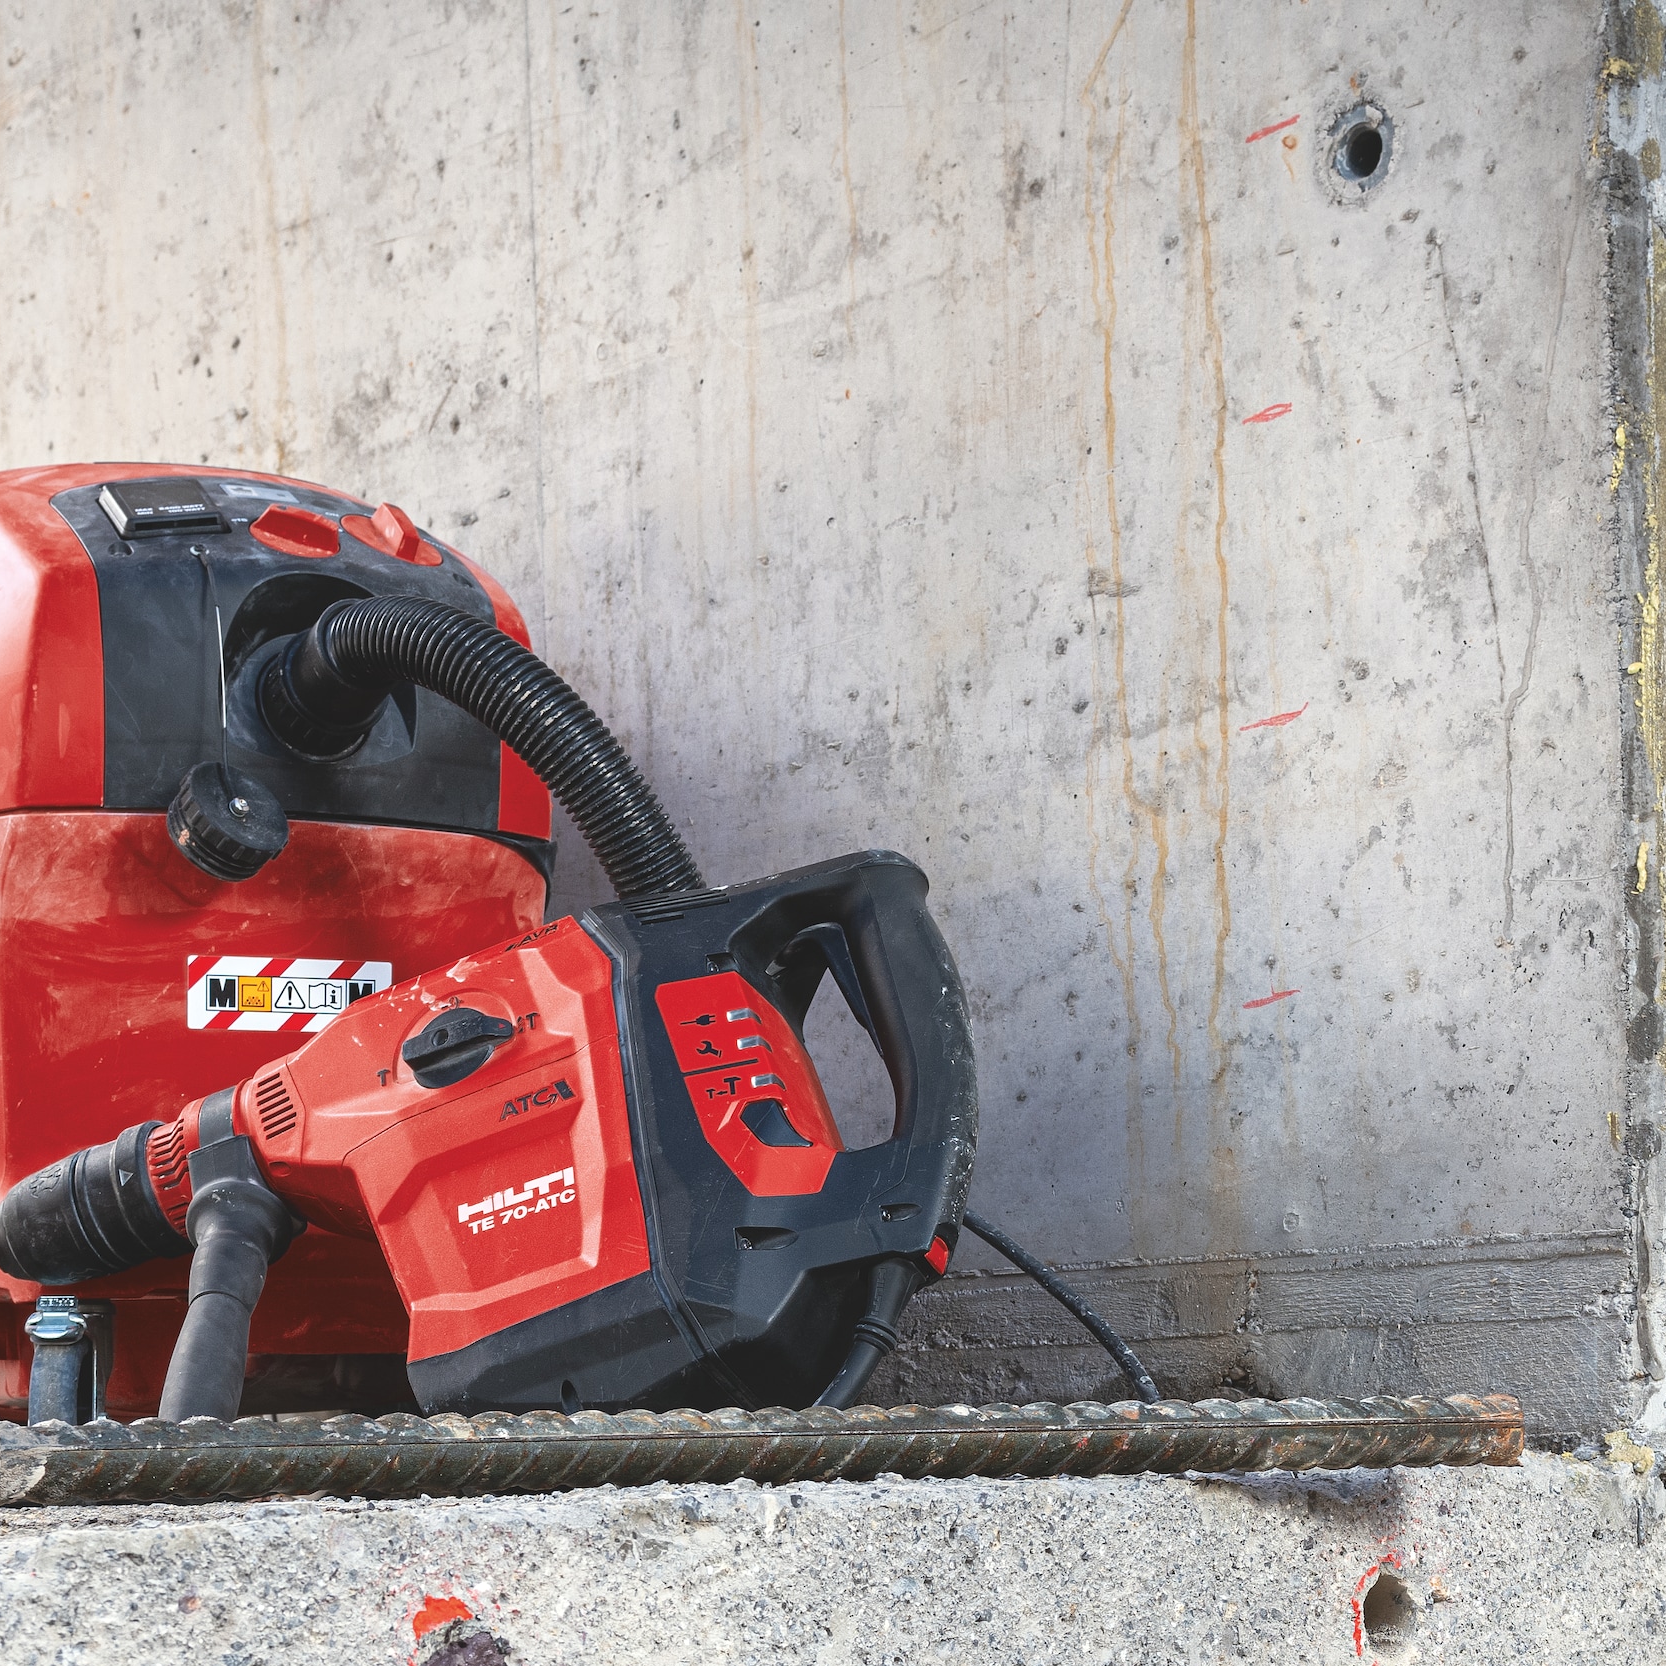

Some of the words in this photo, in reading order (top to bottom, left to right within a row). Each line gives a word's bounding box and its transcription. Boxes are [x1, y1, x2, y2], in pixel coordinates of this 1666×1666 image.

[516, 924, 558, 947] AVR
[209, 978, 236, 1008] M
[499, 1088, 550, 1121] ATC
[457, 1166, 575, 1224] HILTI
[467, 1215, 495, 1235] TE
[499, 1188, 576, 1225] 70-ATC
